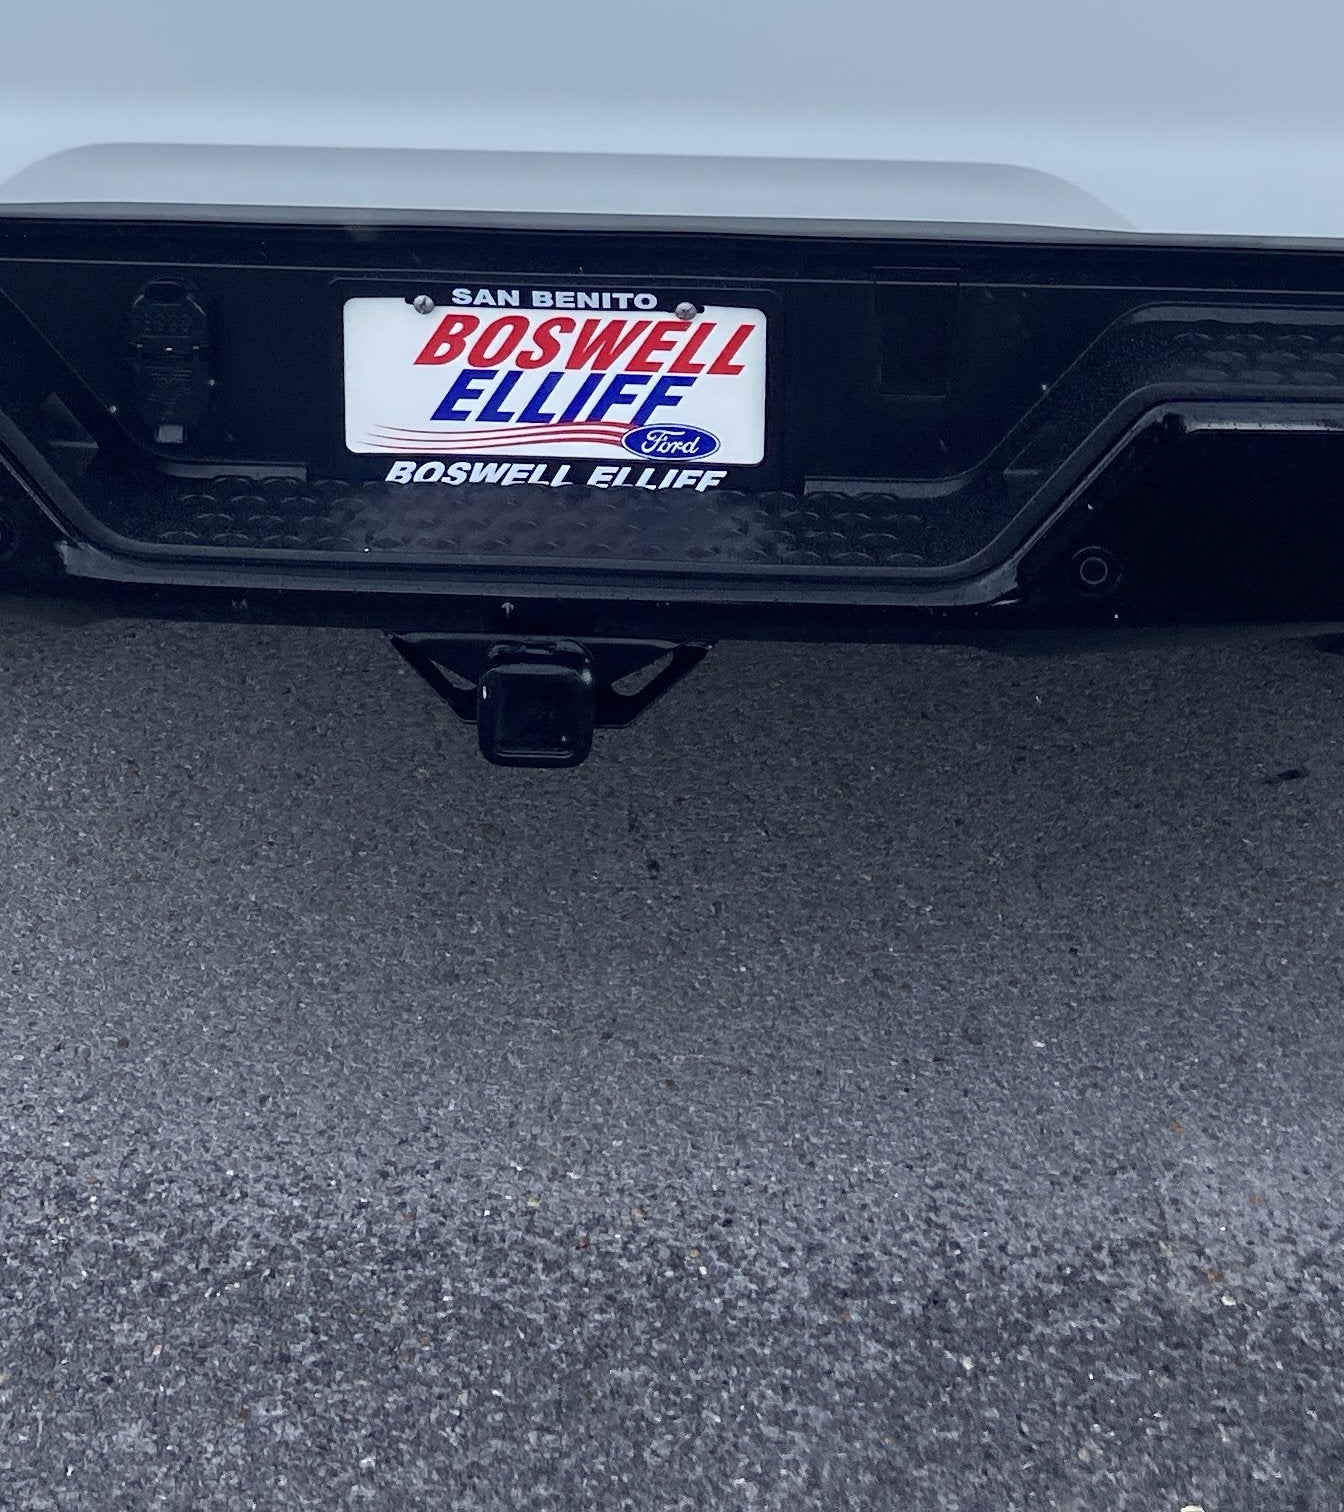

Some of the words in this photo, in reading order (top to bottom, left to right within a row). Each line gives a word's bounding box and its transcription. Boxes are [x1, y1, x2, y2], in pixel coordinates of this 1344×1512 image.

[451, 287, 520, 308] SAN
[531, 290, 658, 310] BENITO
[412, 313, 757, 377] BOSWELL
[429, 368, 699, 427] ELLIFF
[640, 429, 702, 456] Ford
[385, 460, 574, 487] BOSWELL
[586, 465, 728, 493] ELLIFF
